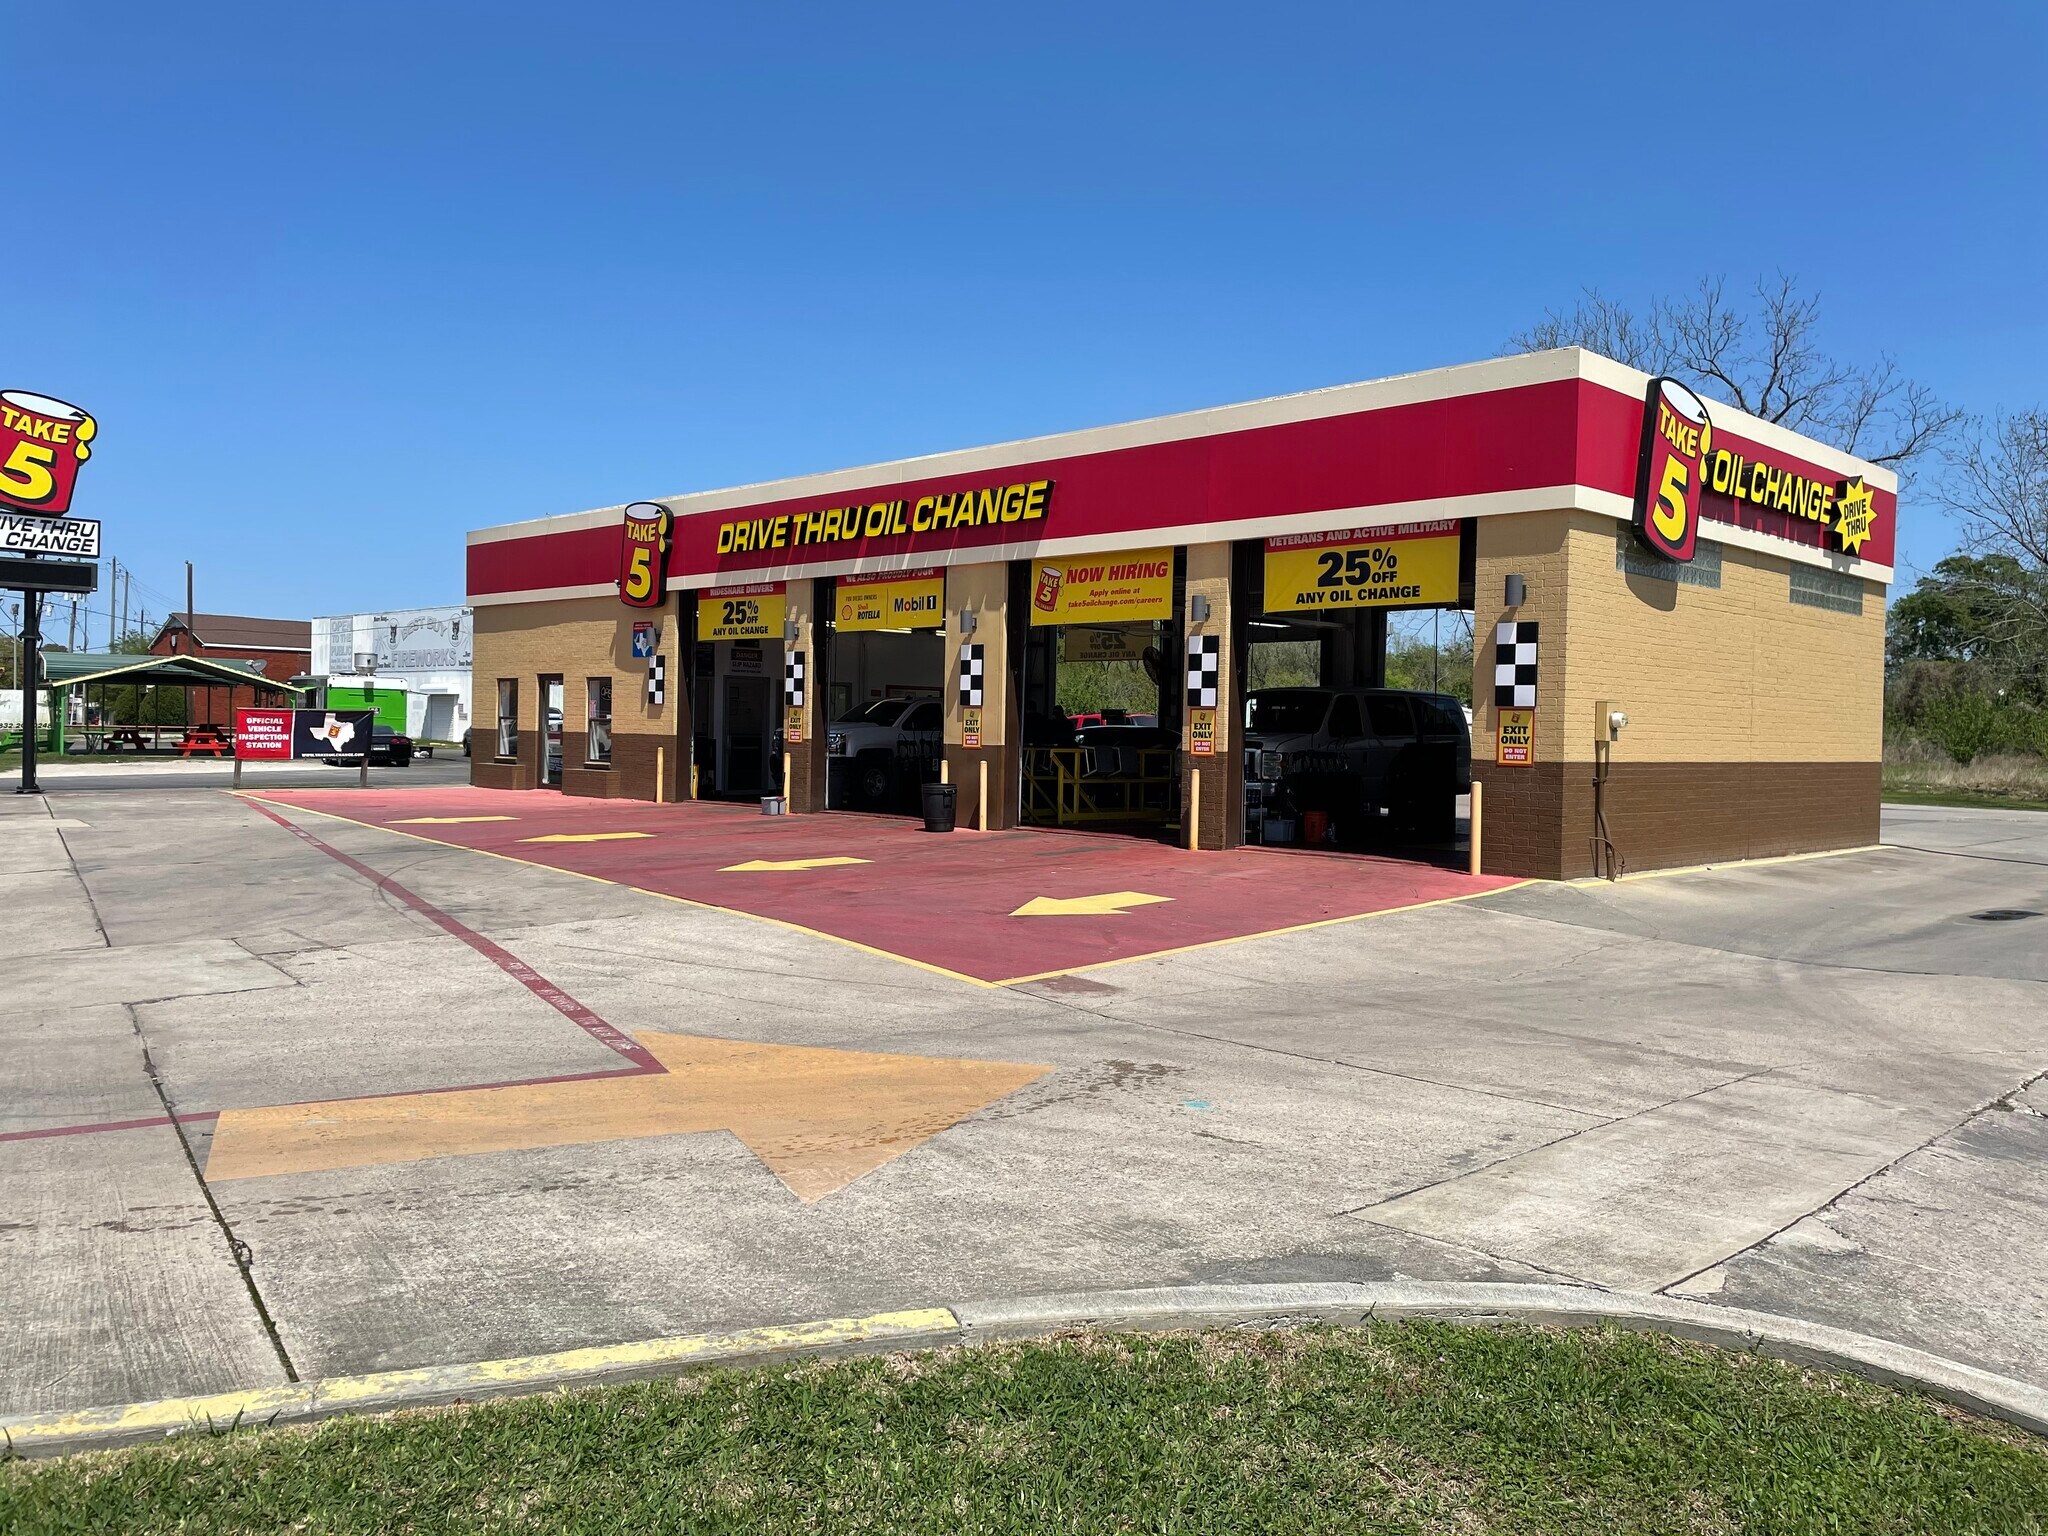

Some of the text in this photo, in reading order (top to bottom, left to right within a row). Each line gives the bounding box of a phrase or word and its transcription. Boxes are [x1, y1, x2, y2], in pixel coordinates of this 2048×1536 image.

[1, 405, 71, 444] TAKE
[1659, 401, 1698, 458] TAKE
[0, 440, 53, 500] 5
[1712, 449, 1834, 524] OIL CHANGE
[1652, 453, 1688, 542] 5
[717, 480, 1049, 554] DRIVE THRU OIL CHANGE
[1843, 498, 1867, 518] DRIVE
[0, 515, 96, 537] IVE THRU
[626, 520, 657, 542] TAKE
[1269, 520, 1456, 547] VETERANS AND ACTIVE MILITARY
[1845, 516, 1867, 538] THRU
[6, 532, 95, 553] CHANGE
[626, 546, 651, 598] 5
[846, 568, 934, 583] WE ALSO PROUDLY POUR
[1065, 561, 1168, 584] NOW HIRING
[1317, 547, 1398, 588] 25%
[1371, 571, 1398, 583] OFF
[1041, 572, 1059, 588] TAKE
[710, 584, 774, 596] RIDESHARE DRIVERS
[1040, 586, 1052, 602] 5
[1089, 588, 1109, 597] Apply
[1110, 587, 1131, 595] online
[1296, 585, 1420, 604] ANY OIL CHANGE
[894, 596, 925, 612] Mobil
[1068, 596, 1163, 608] take5oilchange.com/careers
[722, 600, 759, 625] 25%
[746, 616, 759, 624] OFF
[857, 610, 881, 620] ROTELLA
[712, 625, 769, 636] ANY OIL CHANGE
[391, 648, 457, 668] FIREWORKS
[246, 717, 284, 725] OFFICIAL
[964, 726, 980, 734] ONLY
[1503, 725, 1529, 735] EXIT
[238, 733, 290, 741] INSPECTION
[246, 741, 282, 749] STATION
[1501, 735, 1530, 745] ONLY
